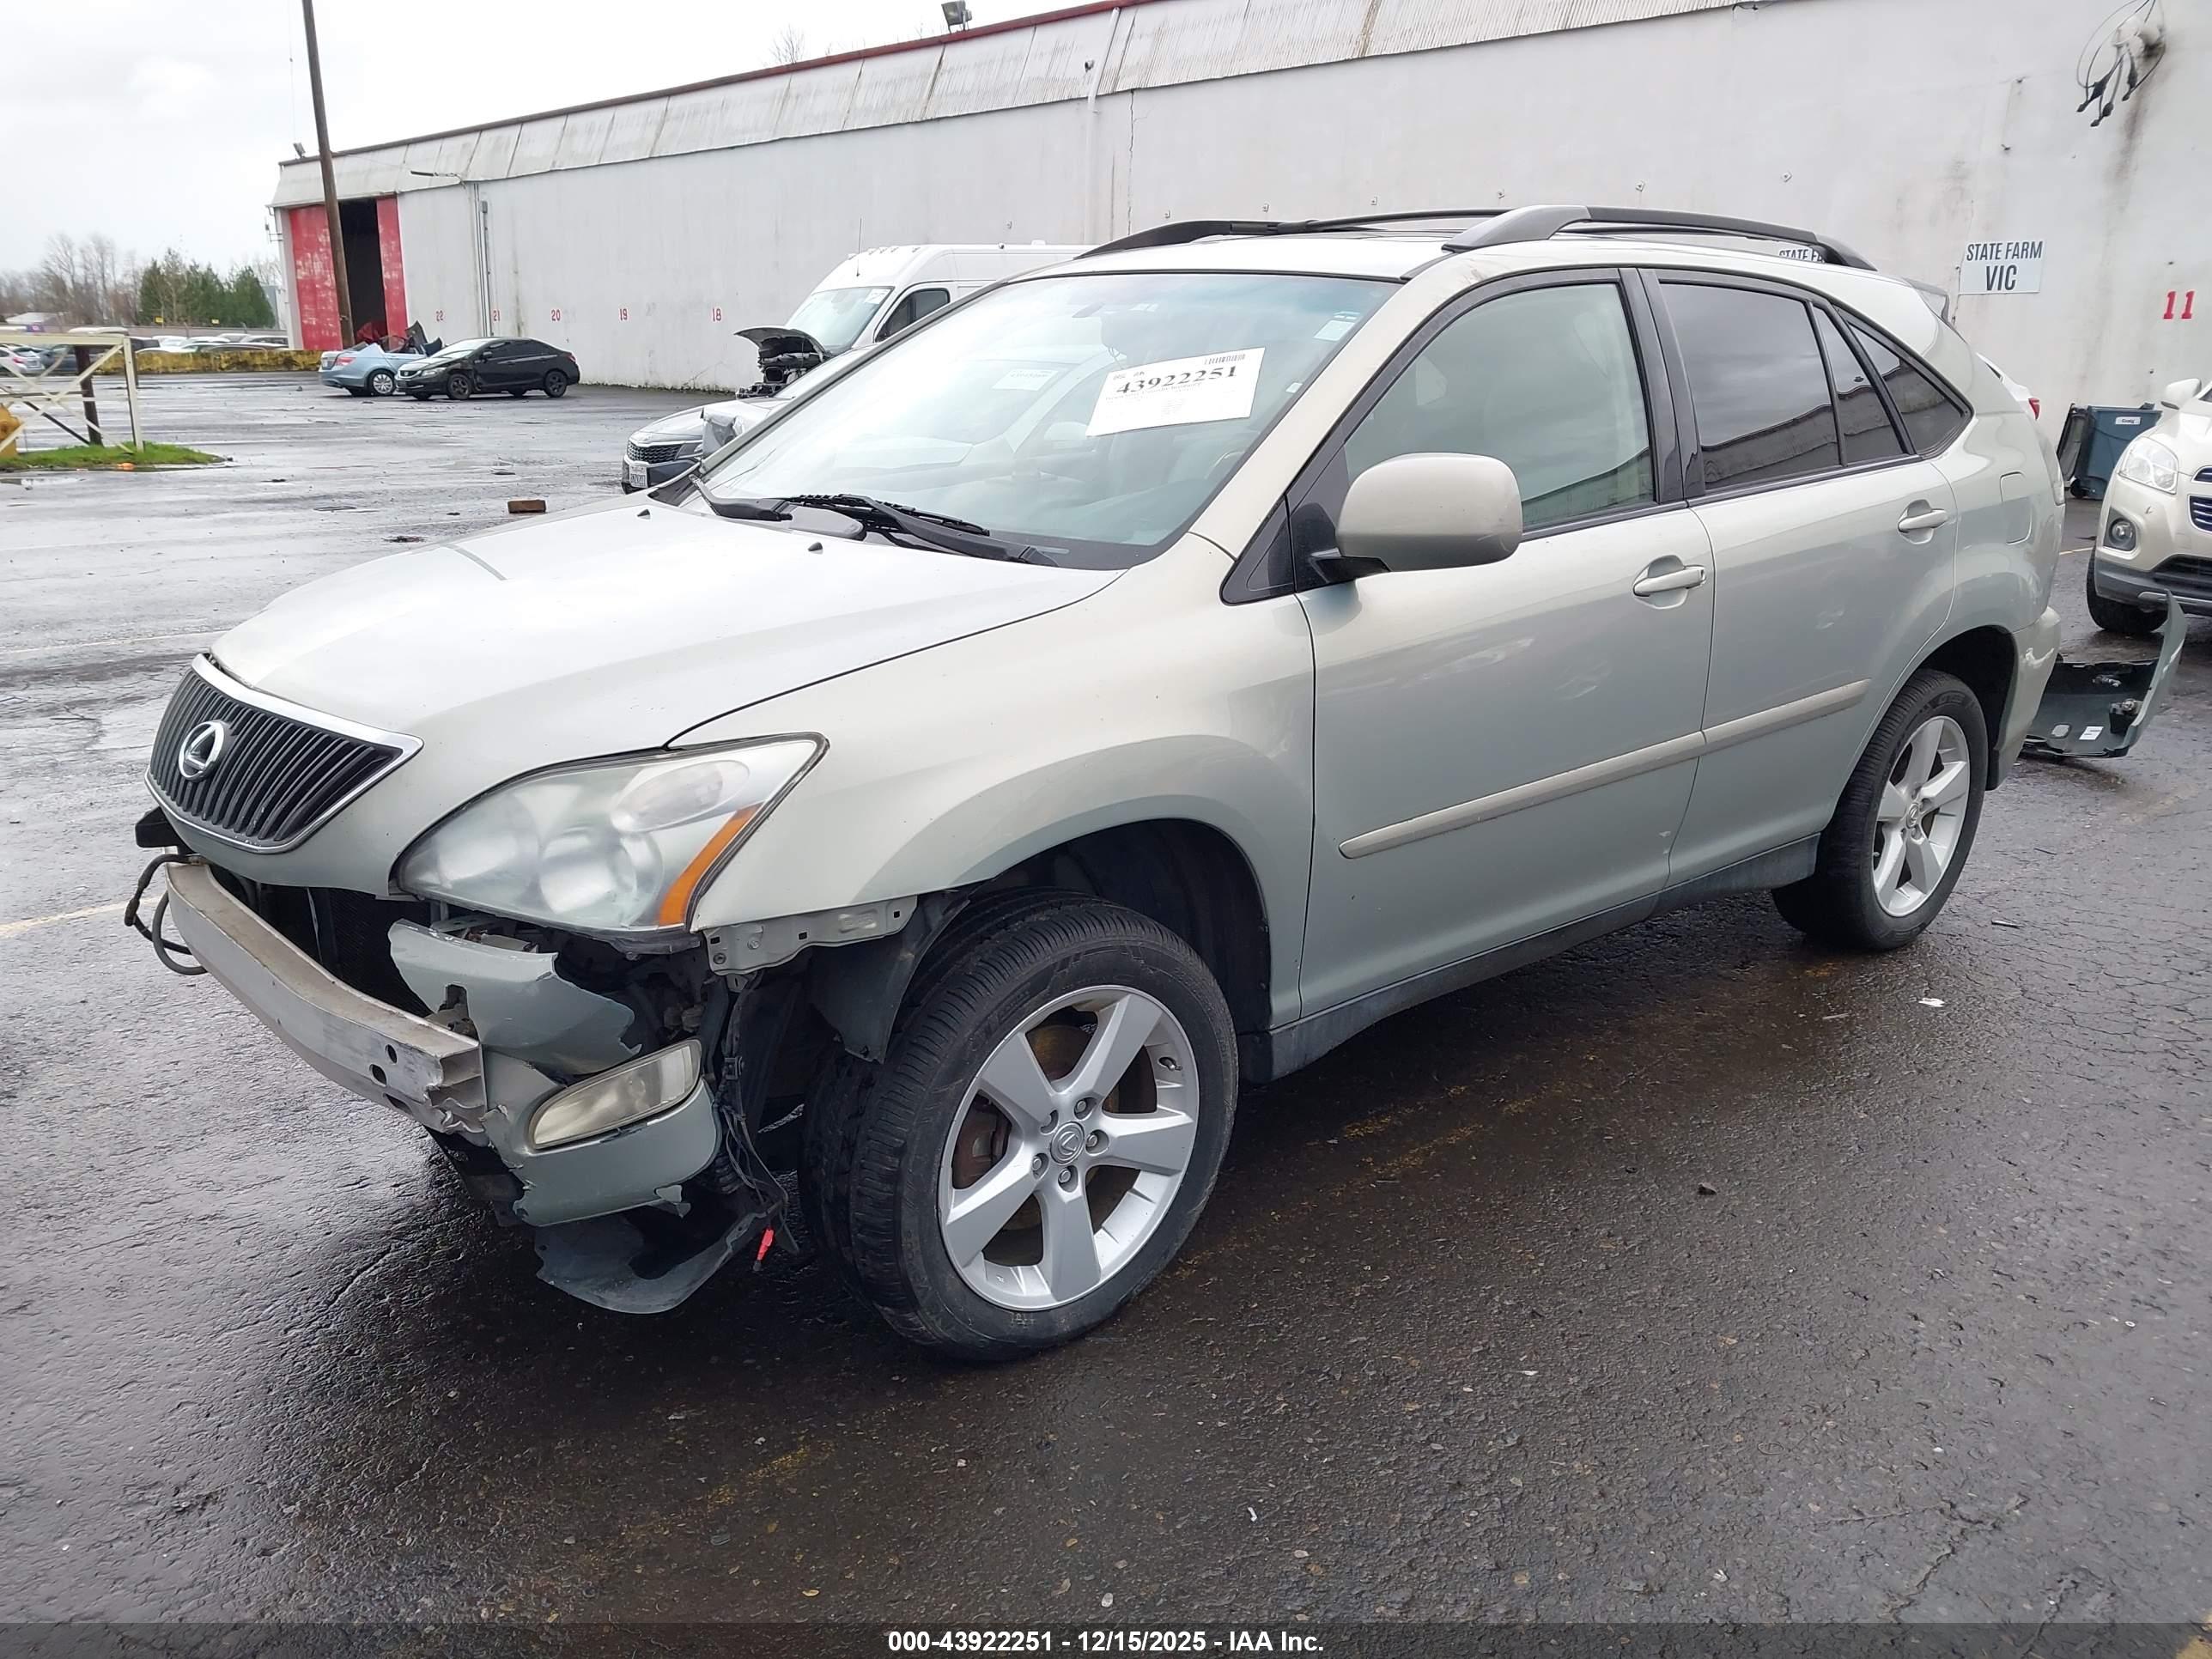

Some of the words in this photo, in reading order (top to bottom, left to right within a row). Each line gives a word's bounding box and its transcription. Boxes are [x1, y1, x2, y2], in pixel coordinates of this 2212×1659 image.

[1966, 242, 2002, 261] STATE
[2005, 240, 2043, 259] FARM
[1986, 264, 2017, 291] VIC
[2164, 291, 2195, 319] 11
[493, 310, 501, 321] 21
[551, 309, 561, 321] 20
[619, 308, 628, 320] 19
[712, 308, 721, 321] 18
[1116, 365, 1237, 394] 43922251
